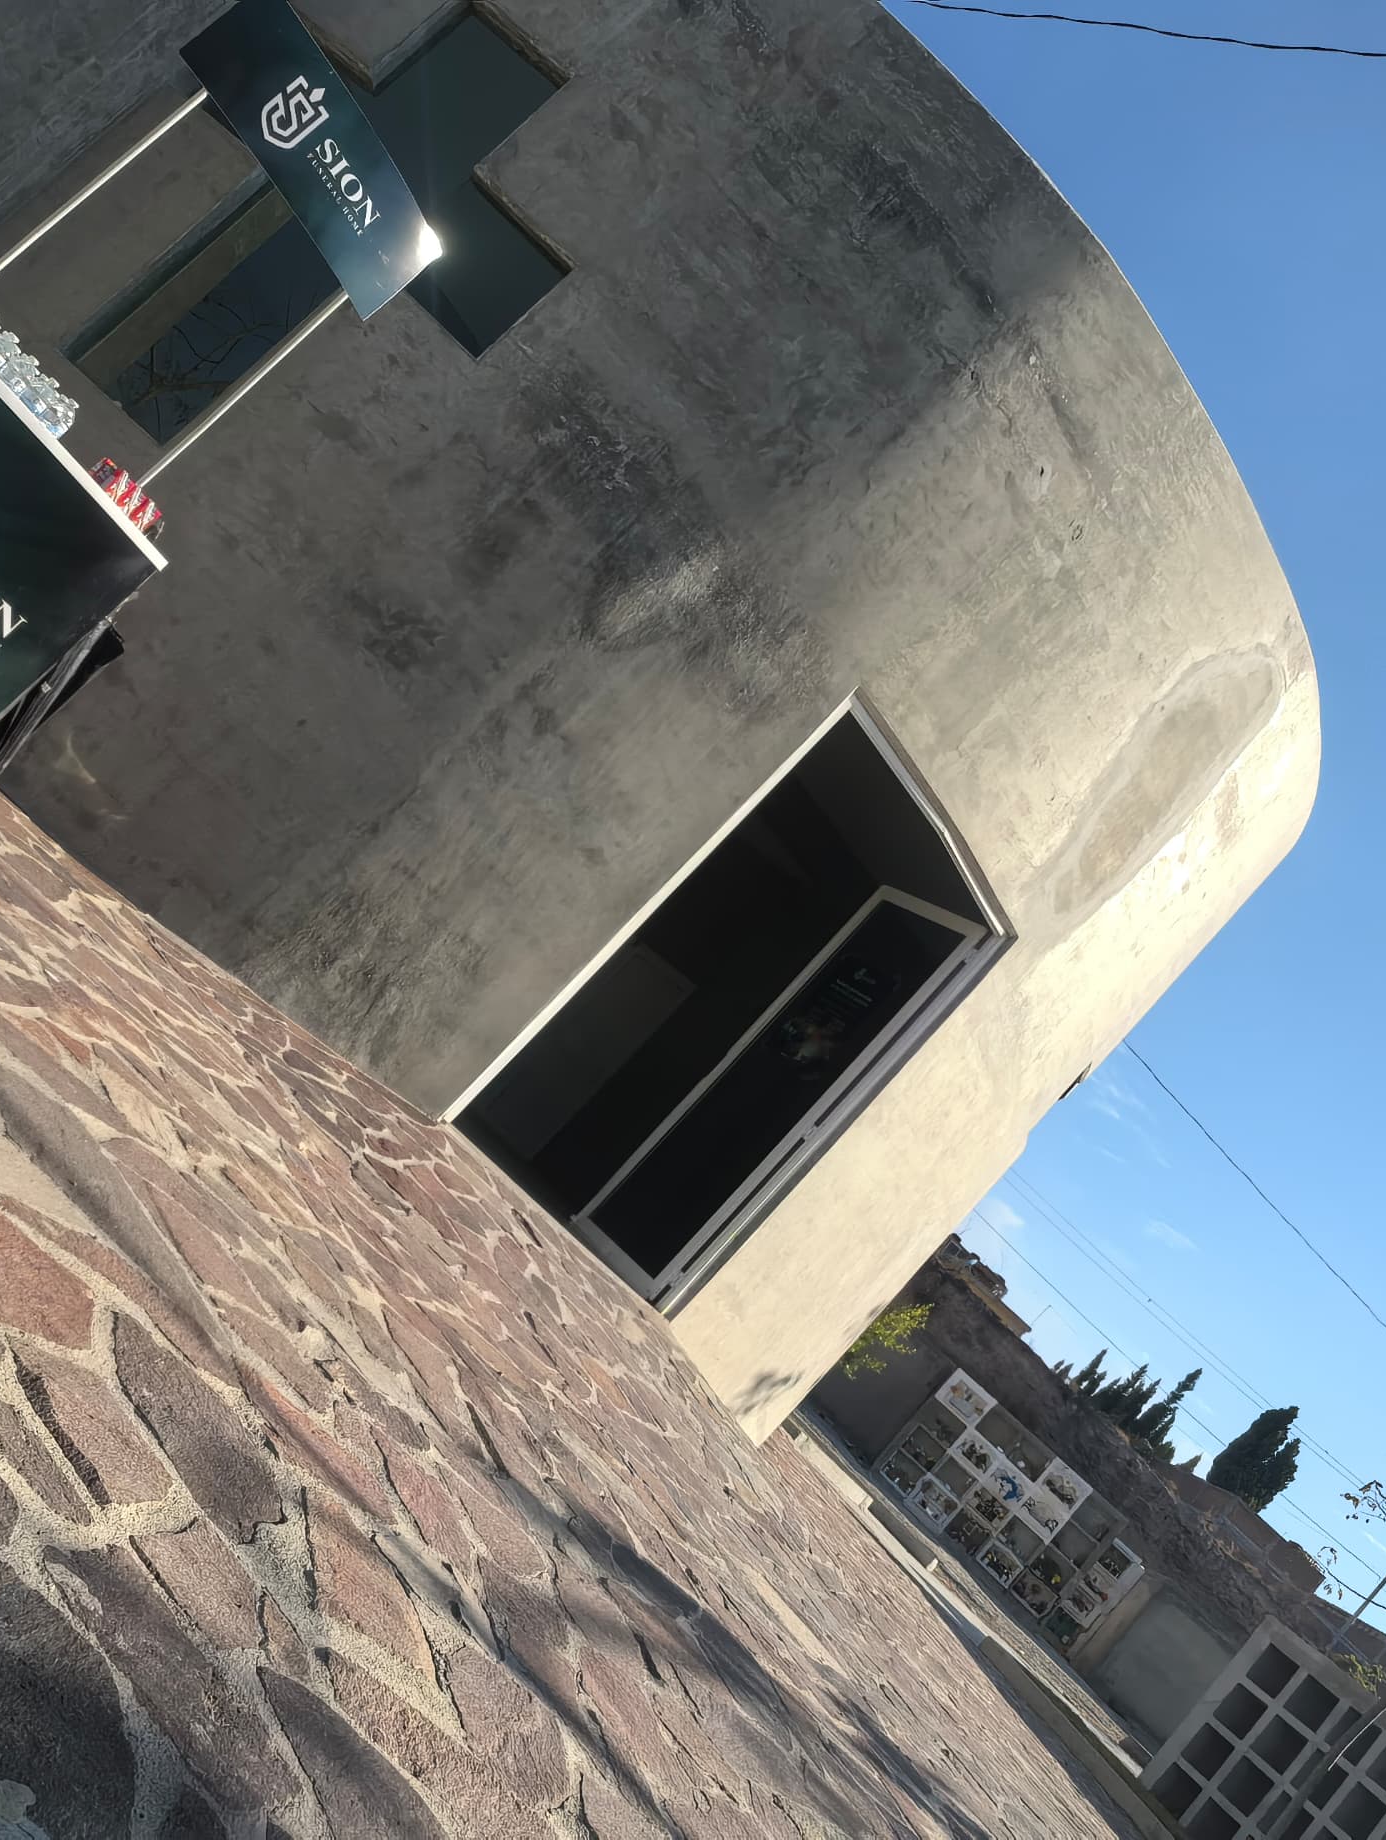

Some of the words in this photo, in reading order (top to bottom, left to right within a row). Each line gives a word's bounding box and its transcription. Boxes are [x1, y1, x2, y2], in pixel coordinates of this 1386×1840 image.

[306, 152, 342, 205] FUNERAL
[342, 206, 364, 238] HOME
[315, 138, 381, 228] SION
